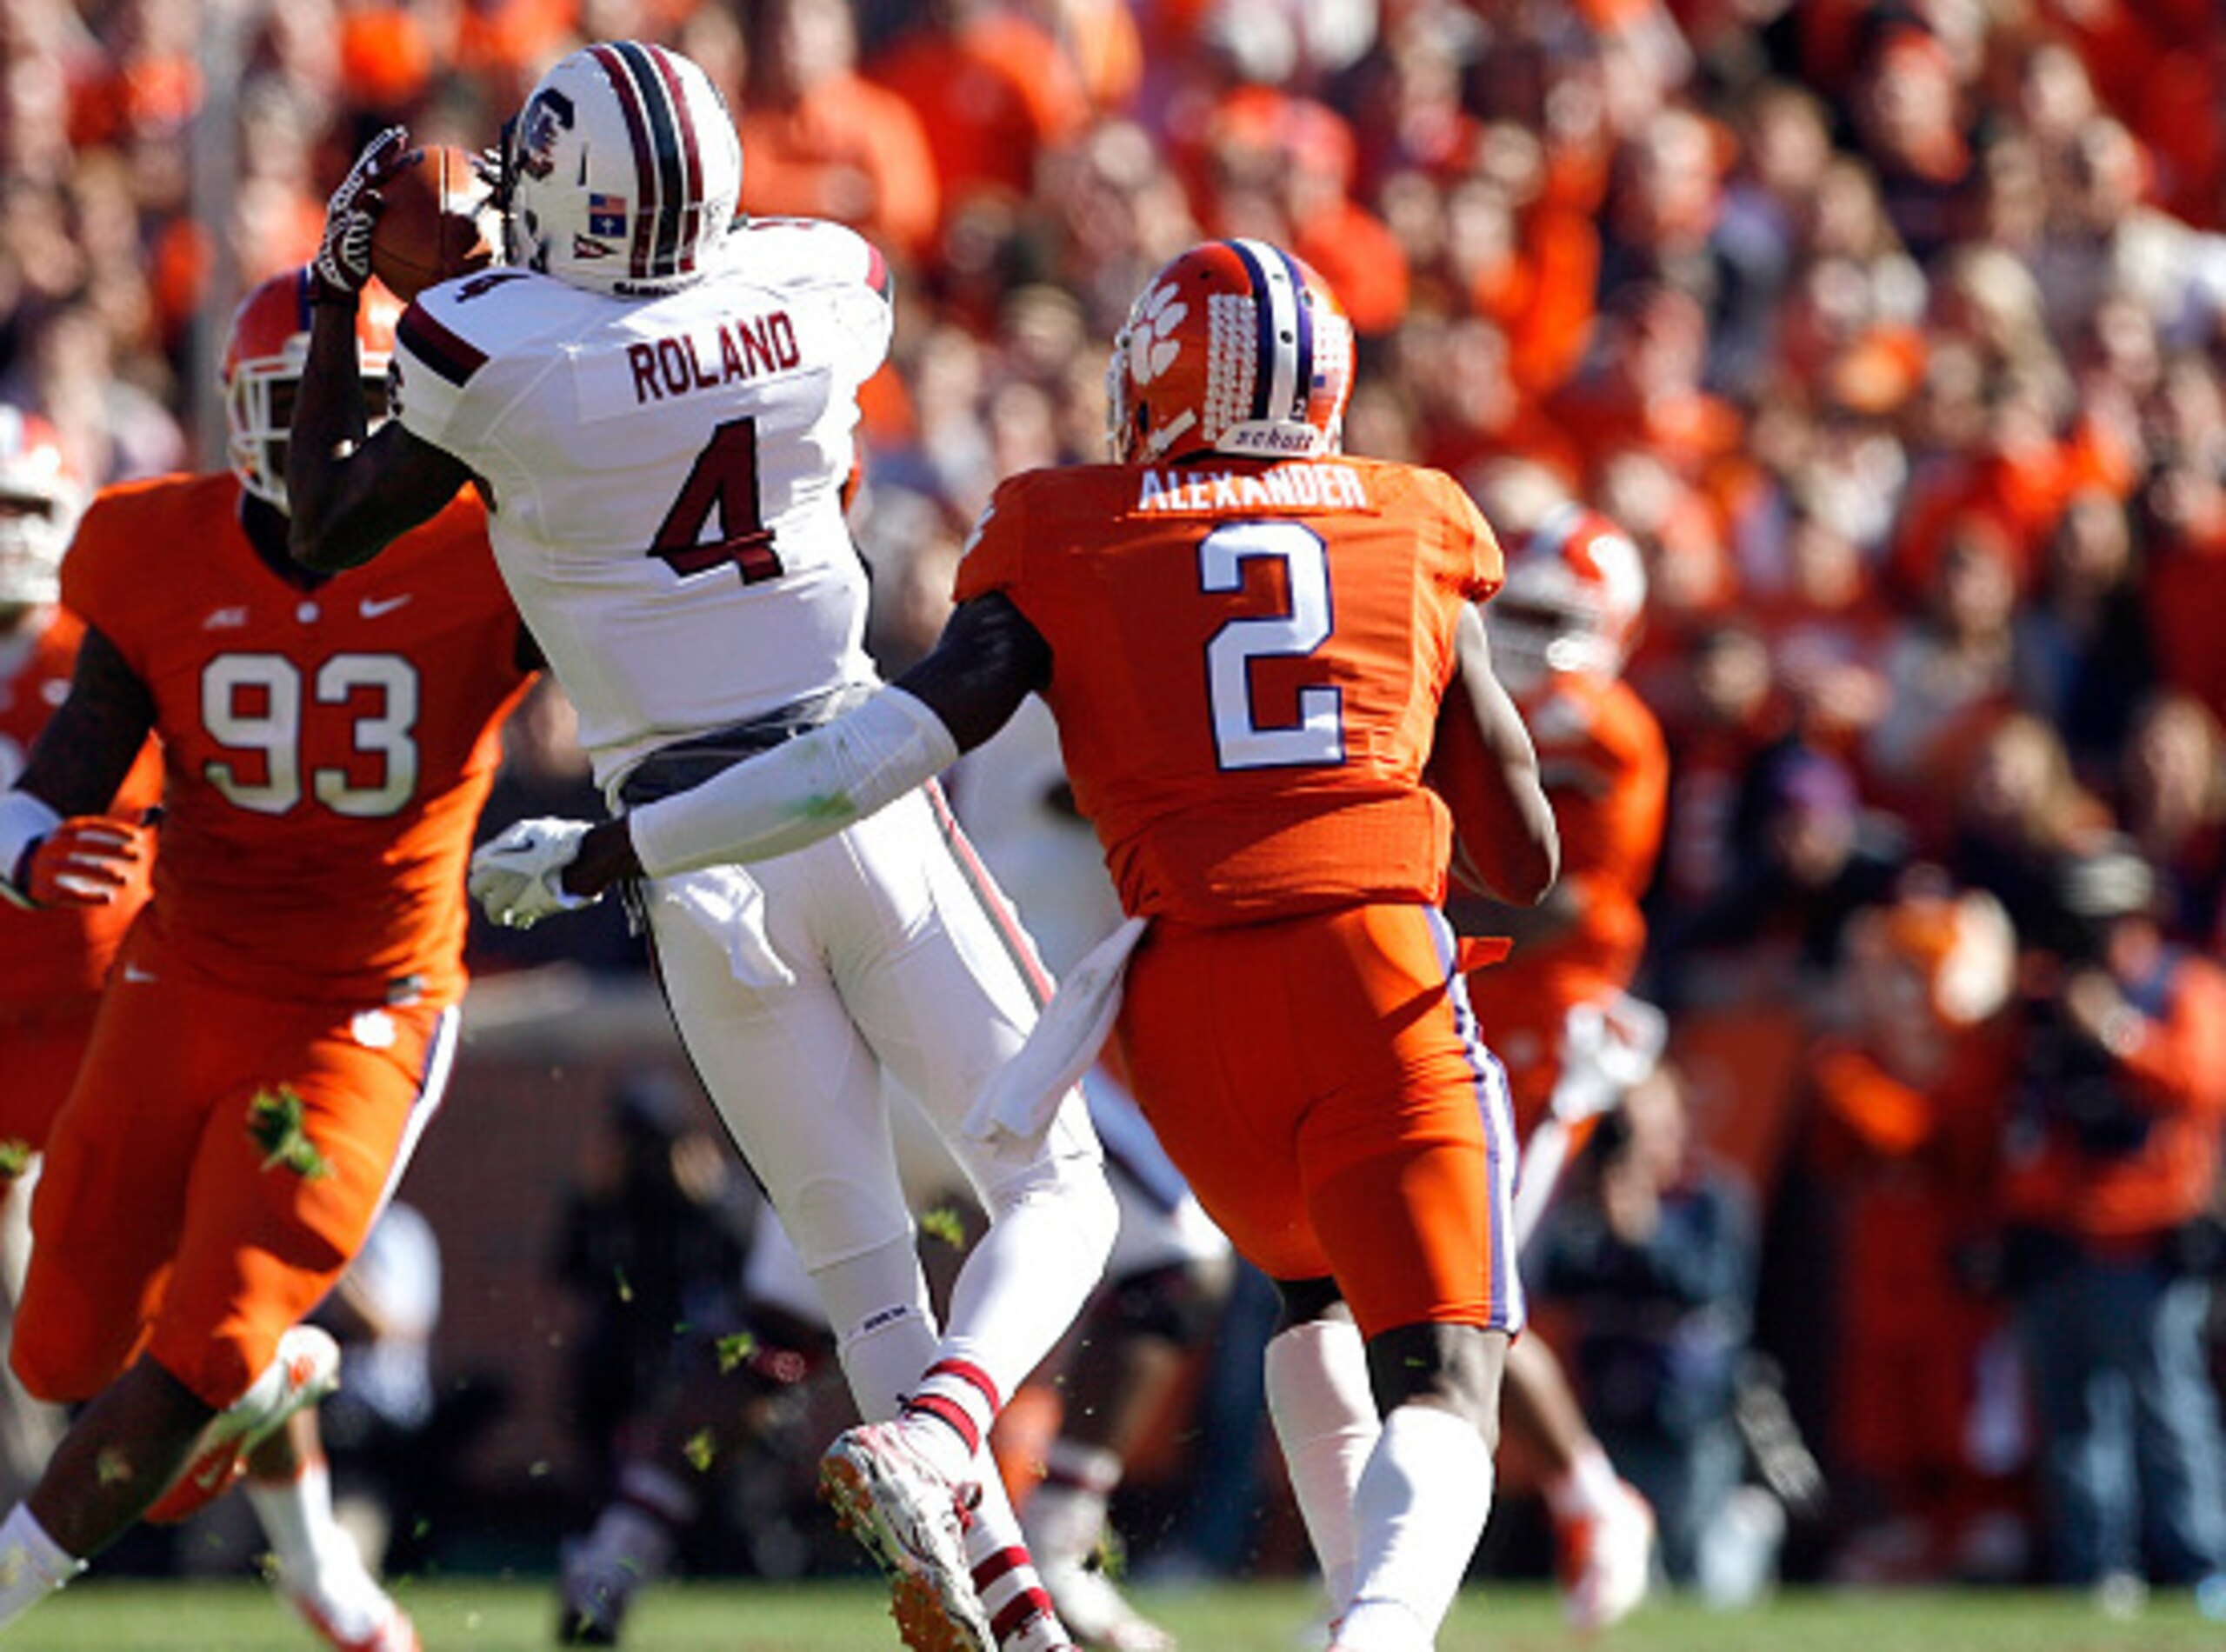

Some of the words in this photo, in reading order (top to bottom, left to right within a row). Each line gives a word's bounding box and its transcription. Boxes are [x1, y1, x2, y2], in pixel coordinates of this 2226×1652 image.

[627, 310, 800, 403] ROLAND
[647, 416, 784, 585] 4
[1138, 464, 1367, 510] ALEXANDER
[1198, 521, 1346, 770] 2
[201, 653, 419, 816] 93
